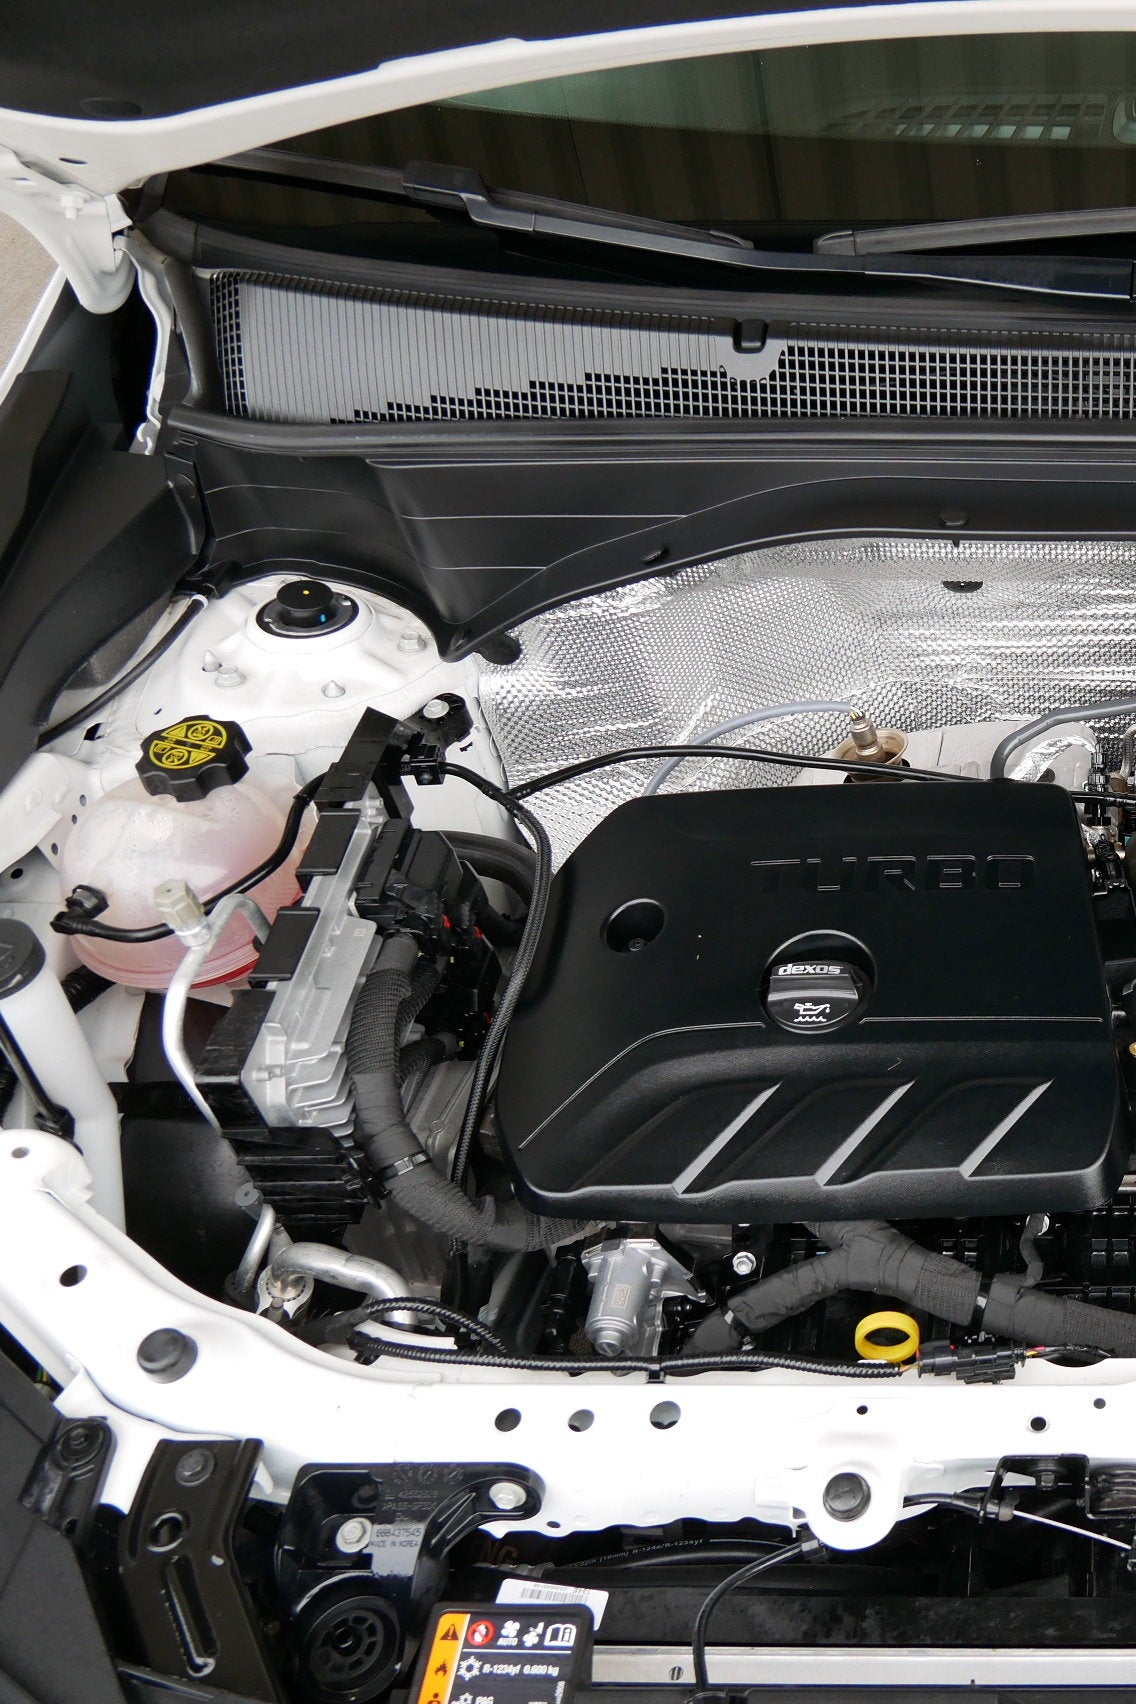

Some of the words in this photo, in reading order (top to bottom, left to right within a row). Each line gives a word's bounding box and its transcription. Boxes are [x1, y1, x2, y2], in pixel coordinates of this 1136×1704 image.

[750, 854, 1036, 894] TURBO
[778, 963, 844, 976] dexos
[497, 1636, 519, 1647] AUTO
